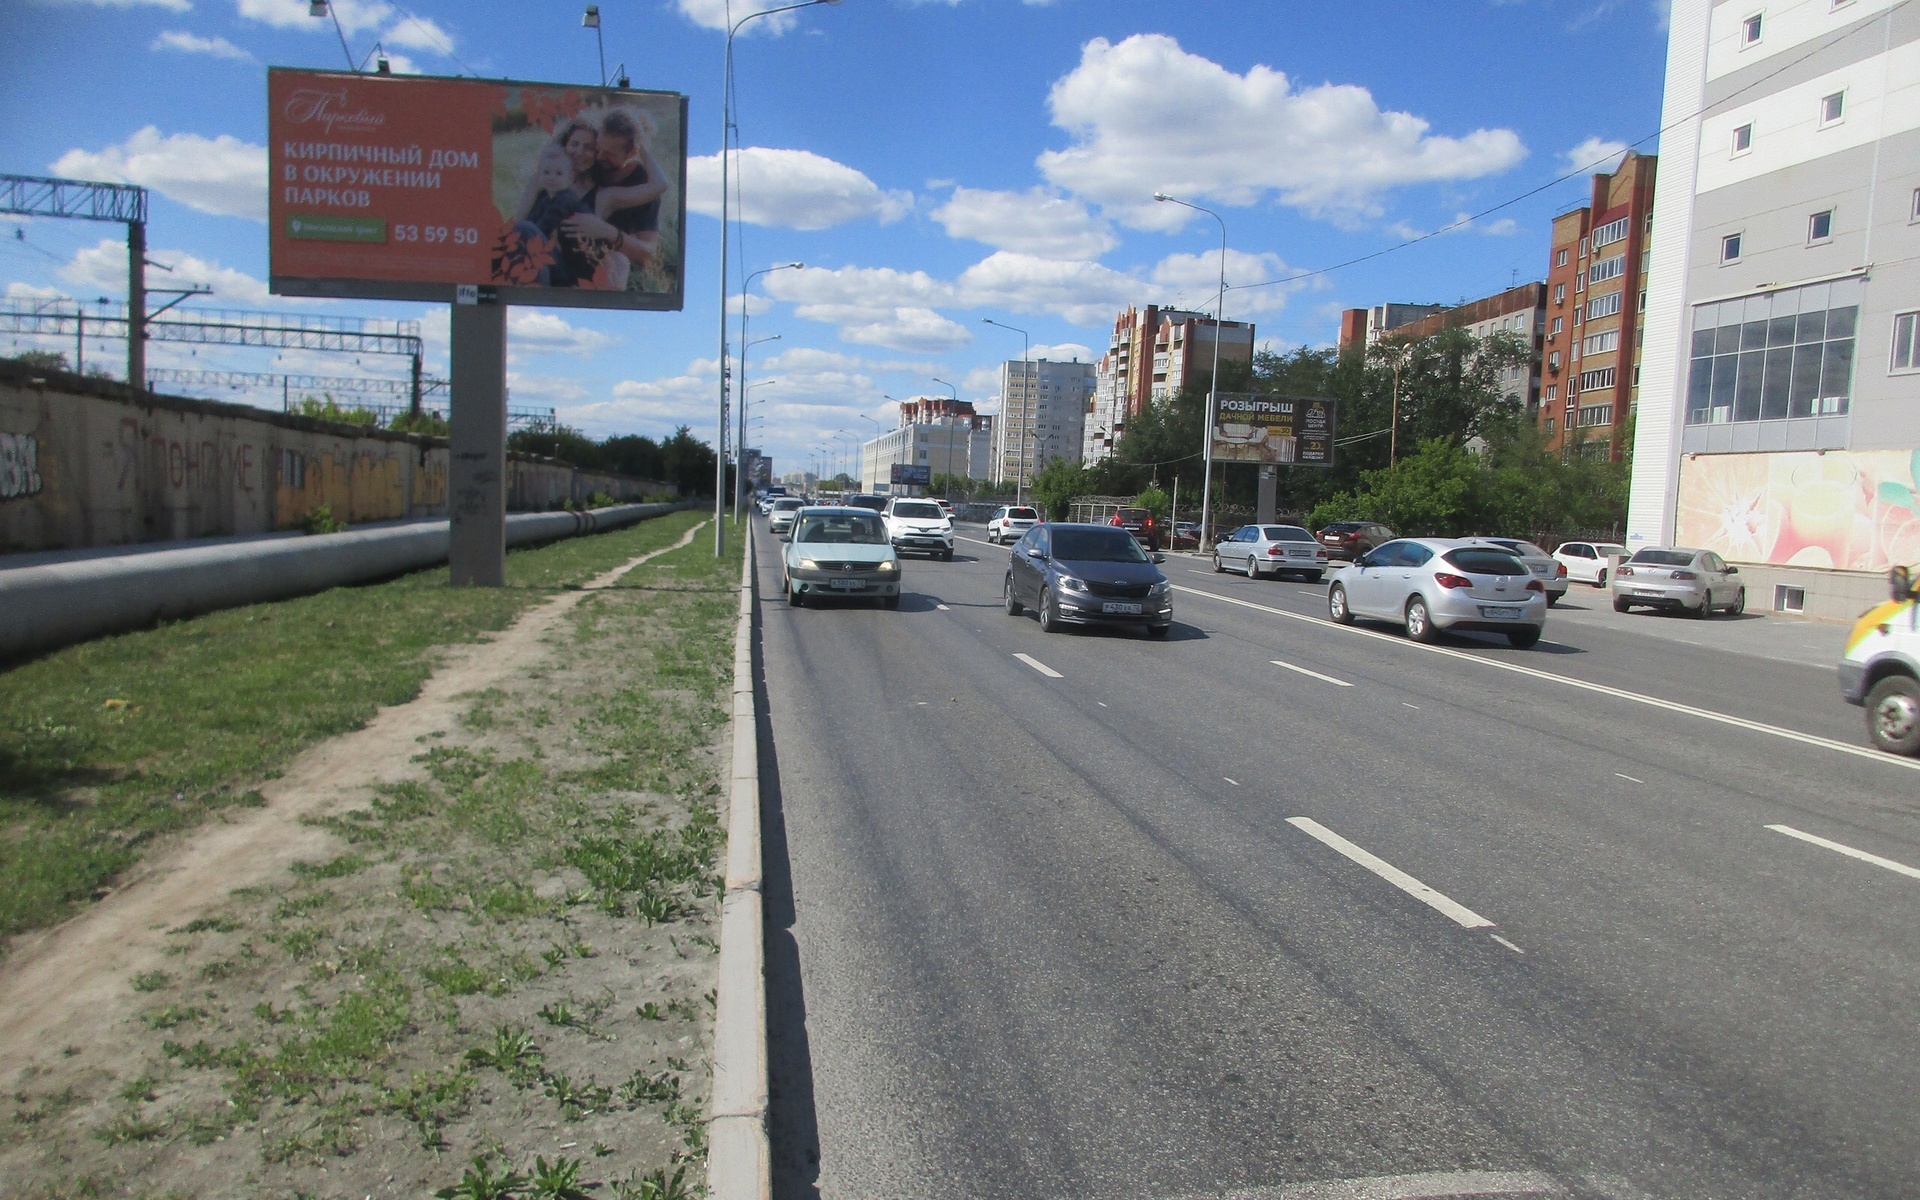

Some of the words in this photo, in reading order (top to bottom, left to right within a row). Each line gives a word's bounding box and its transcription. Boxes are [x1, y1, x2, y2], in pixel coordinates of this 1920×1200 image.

[284, 142, 422, 165] КИРПИЧНЫЙ
[428, 149, 479, 169] ДОМ
[284, 164, 298, 181] В
[303, 165, 441, 188] ОКРУЖЕНИИ
[284, 186, 371, 207] ПАРКОВ
[394, 224, 419, 242] 53
[424, 225, 448, 243] 59
[454, 227, 479, 244] 50
[1220, 400, 1293, 413] РОЗЫГРЫШ
[1219, 412, 1255, 421] ДАЧНОЙ
[1257, 414, 1293, 422] МЕБЕЛИ
